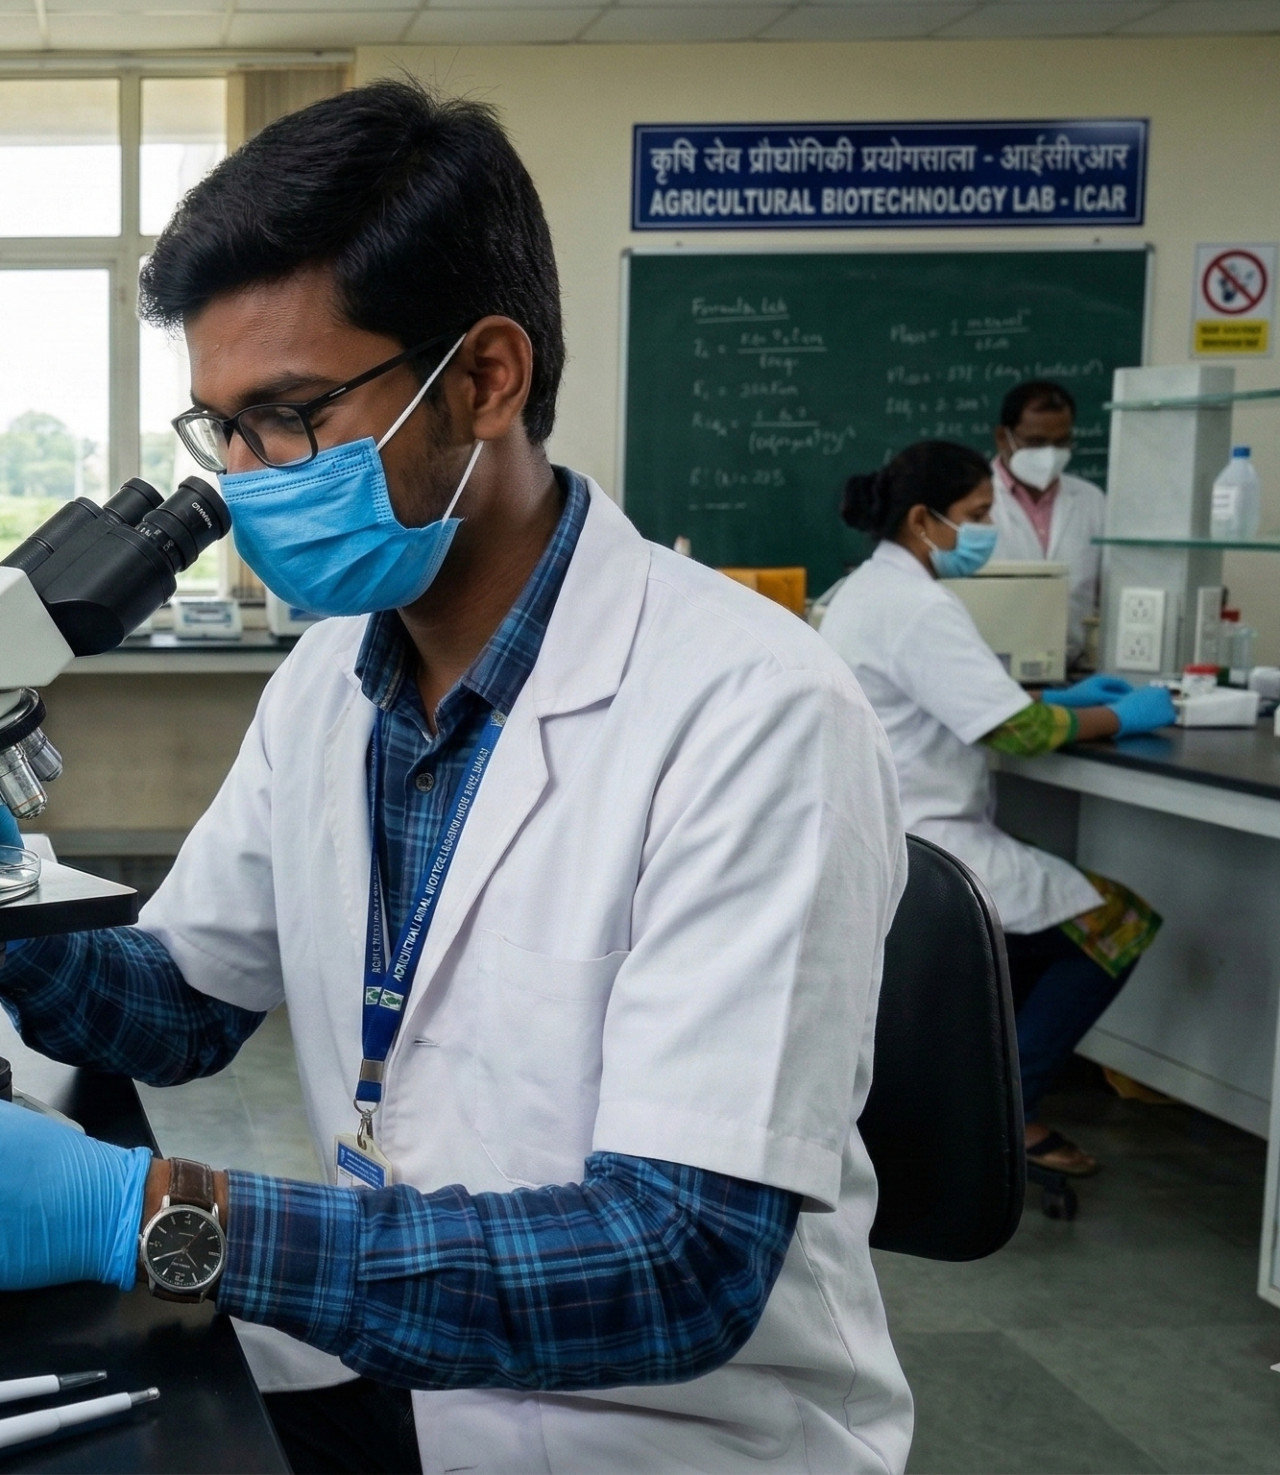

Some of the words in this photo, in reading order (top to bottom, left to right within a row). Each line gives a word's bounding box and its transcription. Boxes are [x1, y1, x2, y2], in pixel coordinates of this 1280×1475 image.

[649, 137, 699, 185] कृषि
[649, 187, 816, 217] AGRICULTURAL
[821, 186, 1008, 215] BIOTECHNOLOGY
[1012, 185, 1057, 213] LAB
[1074, 184, 1127, 212] ICAR
